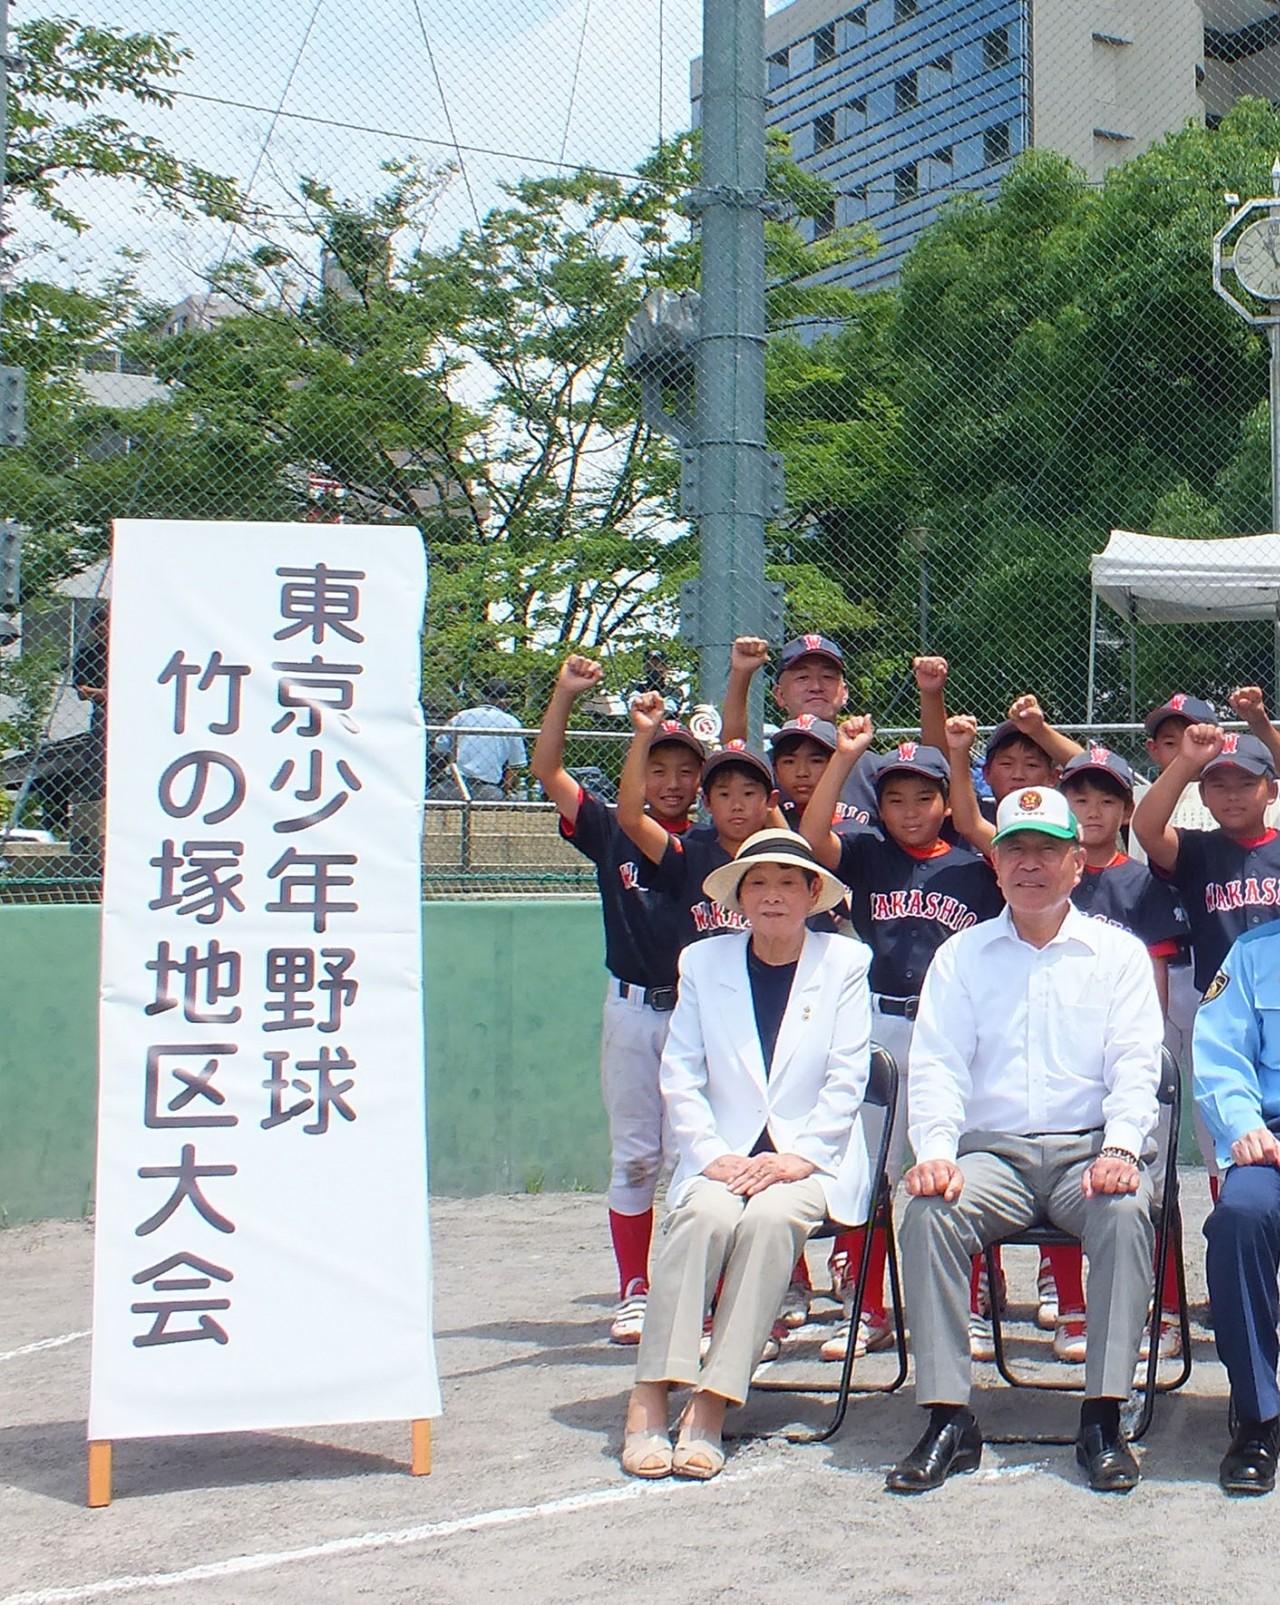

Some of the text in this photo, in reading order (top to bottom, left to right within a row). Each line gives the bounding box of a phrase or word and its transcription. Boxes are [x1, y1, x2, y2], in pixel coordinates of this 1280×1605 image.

[804, 633, 823, 650] W
[1170, 693, 1187, 711] W
[796, 713, 817, 730] W
[898, 741, 918, 762] W
[1221, 732, 1240, 754] W
[1090, 744, 1111, 765] W
[259, 561, 367, 1136] 東京少年野球
[870, 889, 977, 931] AKASHIO
[129, 648, 252, 1350] 竹の塚地区大会
